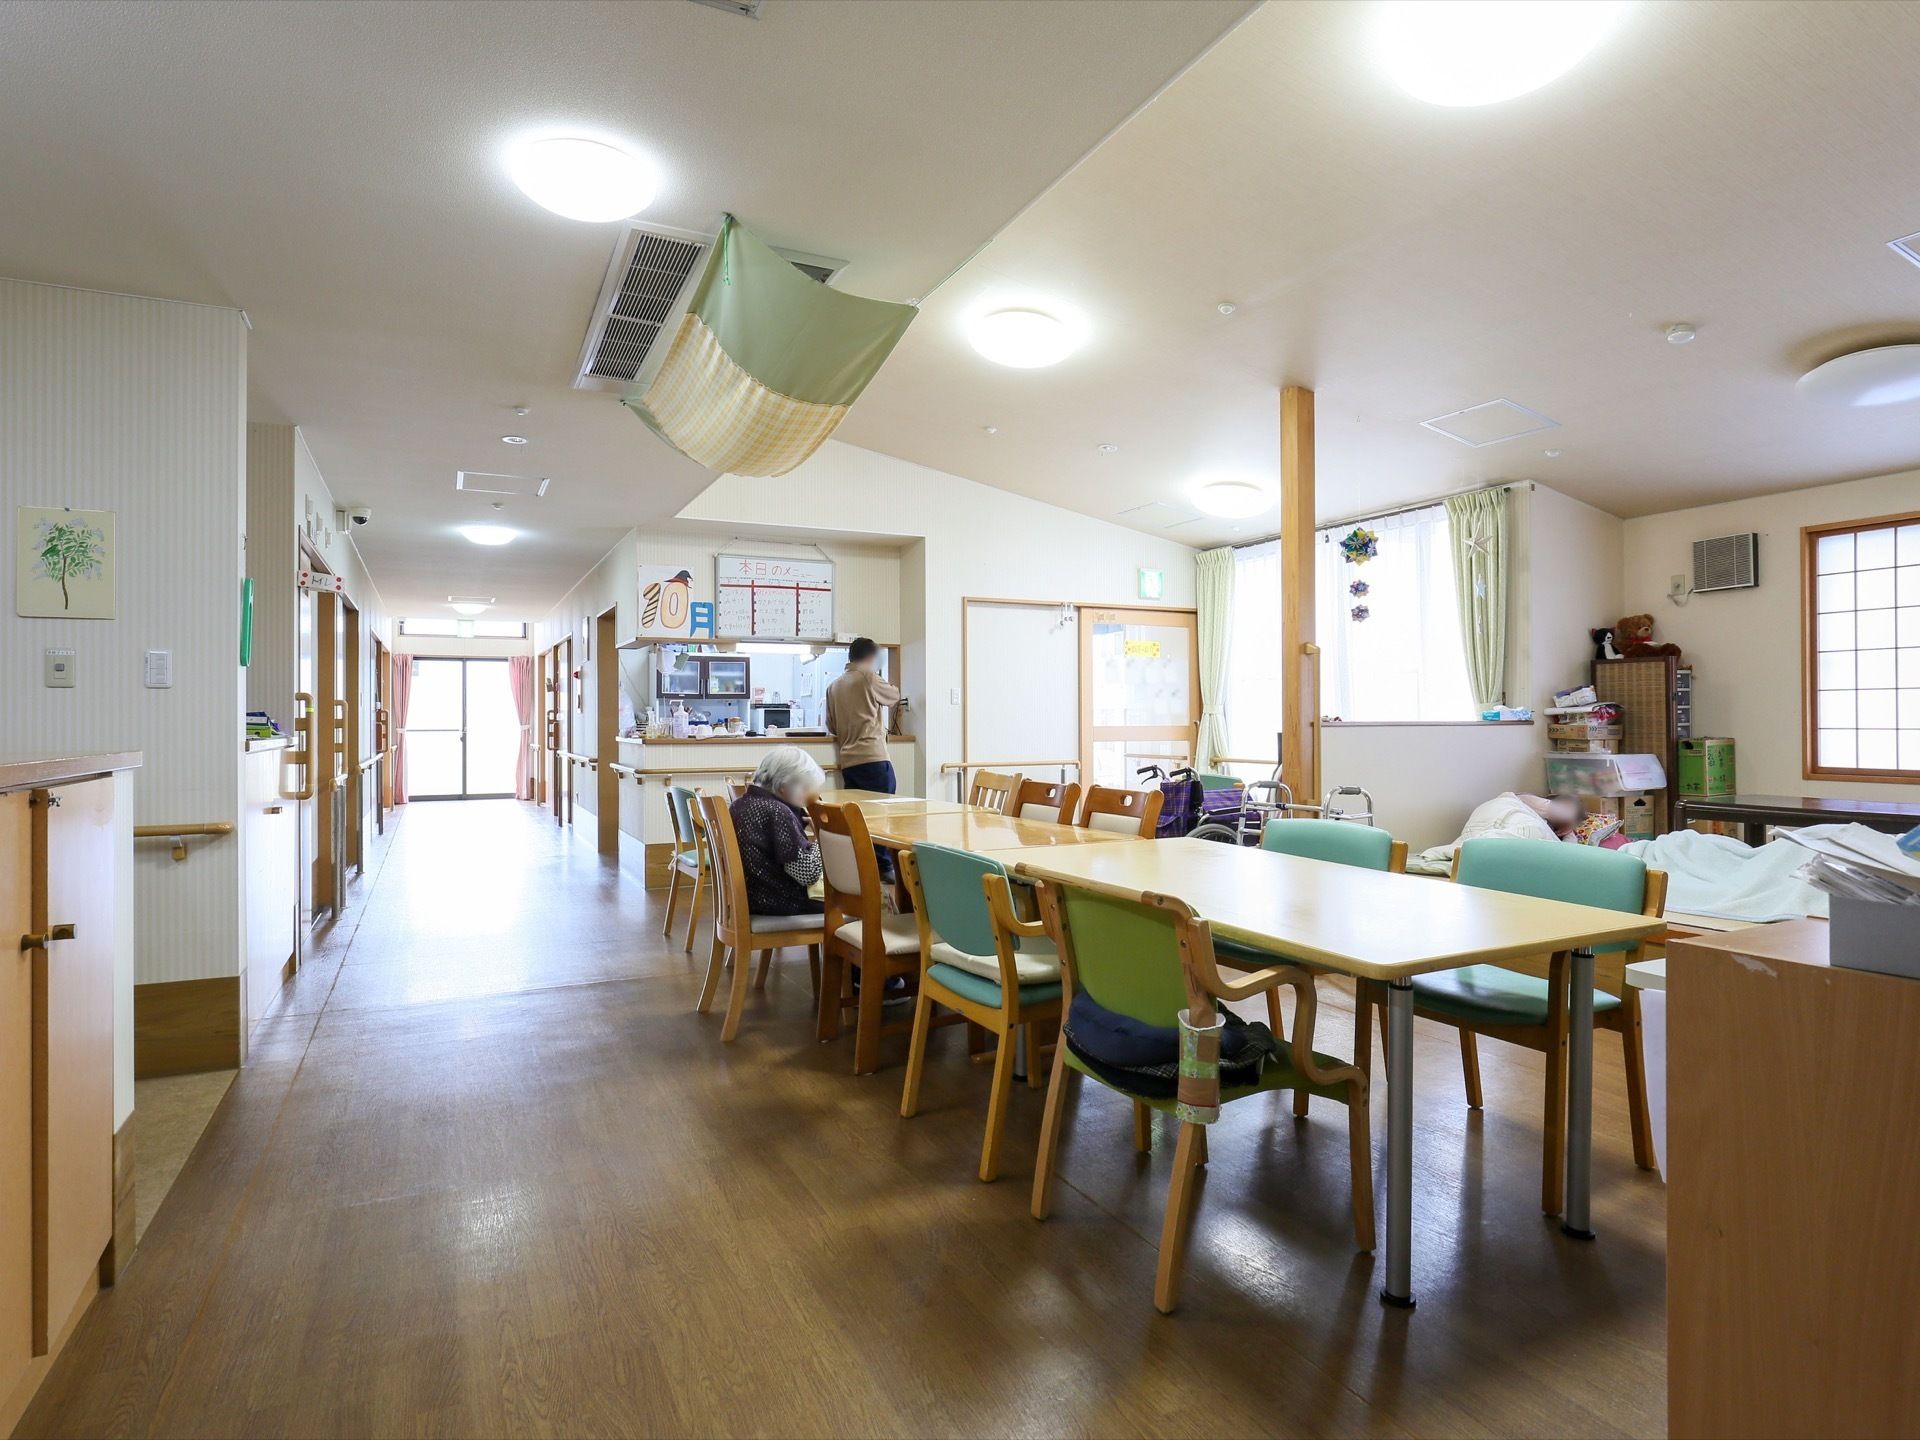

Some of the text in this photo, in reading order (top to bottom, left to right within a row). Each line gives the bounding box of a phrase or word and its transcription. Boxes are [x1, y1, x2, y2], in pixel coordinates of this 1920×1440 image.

[739, 559, 814, 577] 本日のメニュー
[641, 581, 714, 638] 10月
